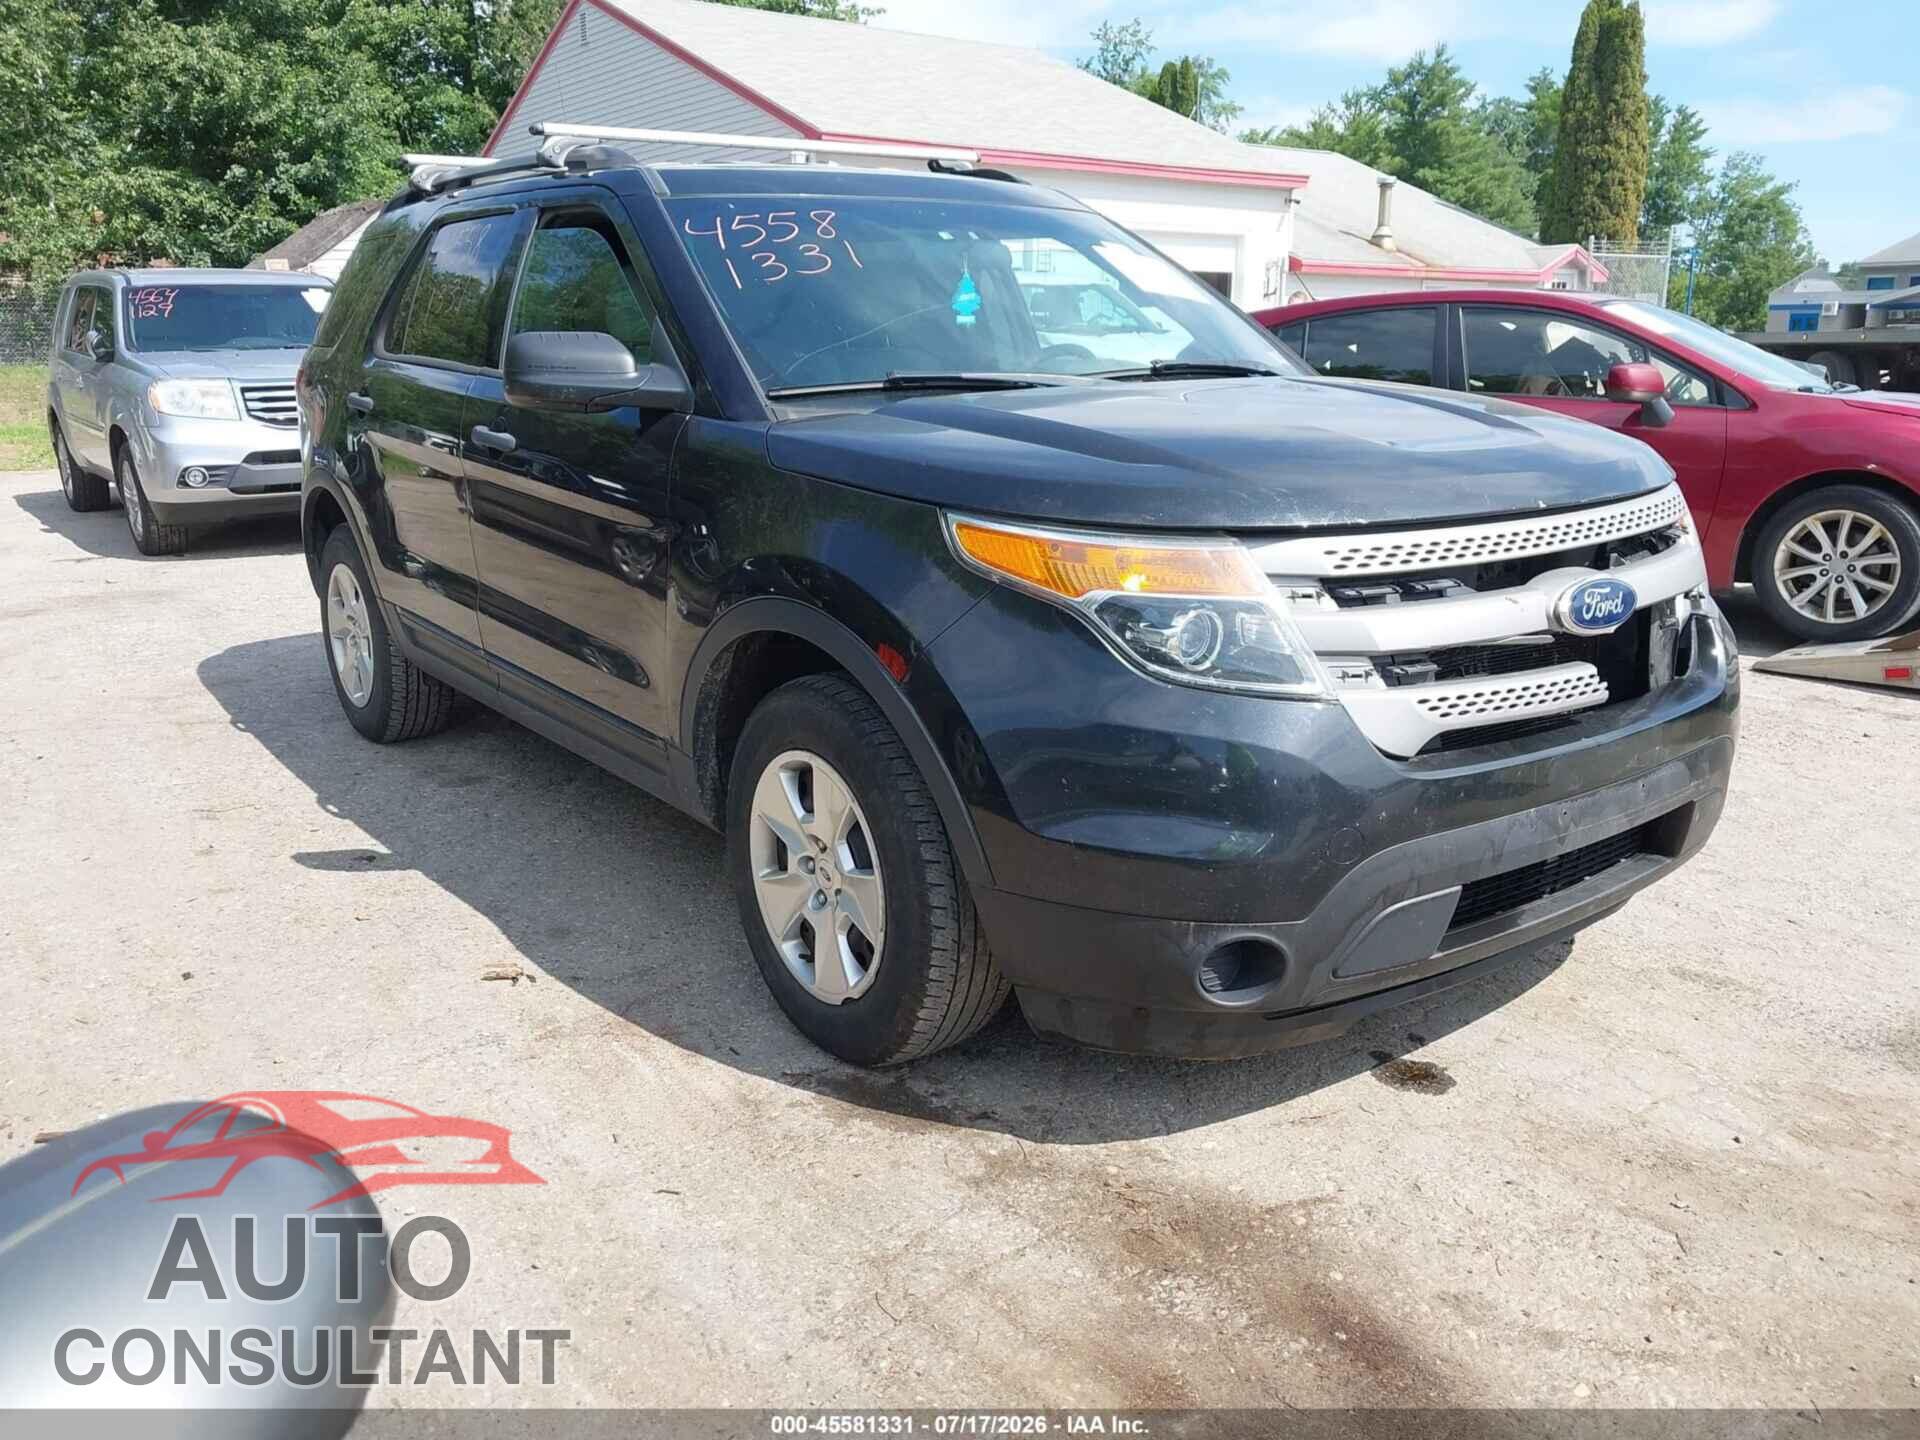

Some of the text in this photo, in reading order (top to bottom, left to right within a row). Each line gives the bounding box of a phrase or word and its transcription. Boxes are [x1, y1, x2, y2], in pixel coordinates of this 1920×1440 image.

[684, 209, 836, 250] 4558
[725, 240, 863, 289] 1331
[1582, 586, 1624, 620] Ford
